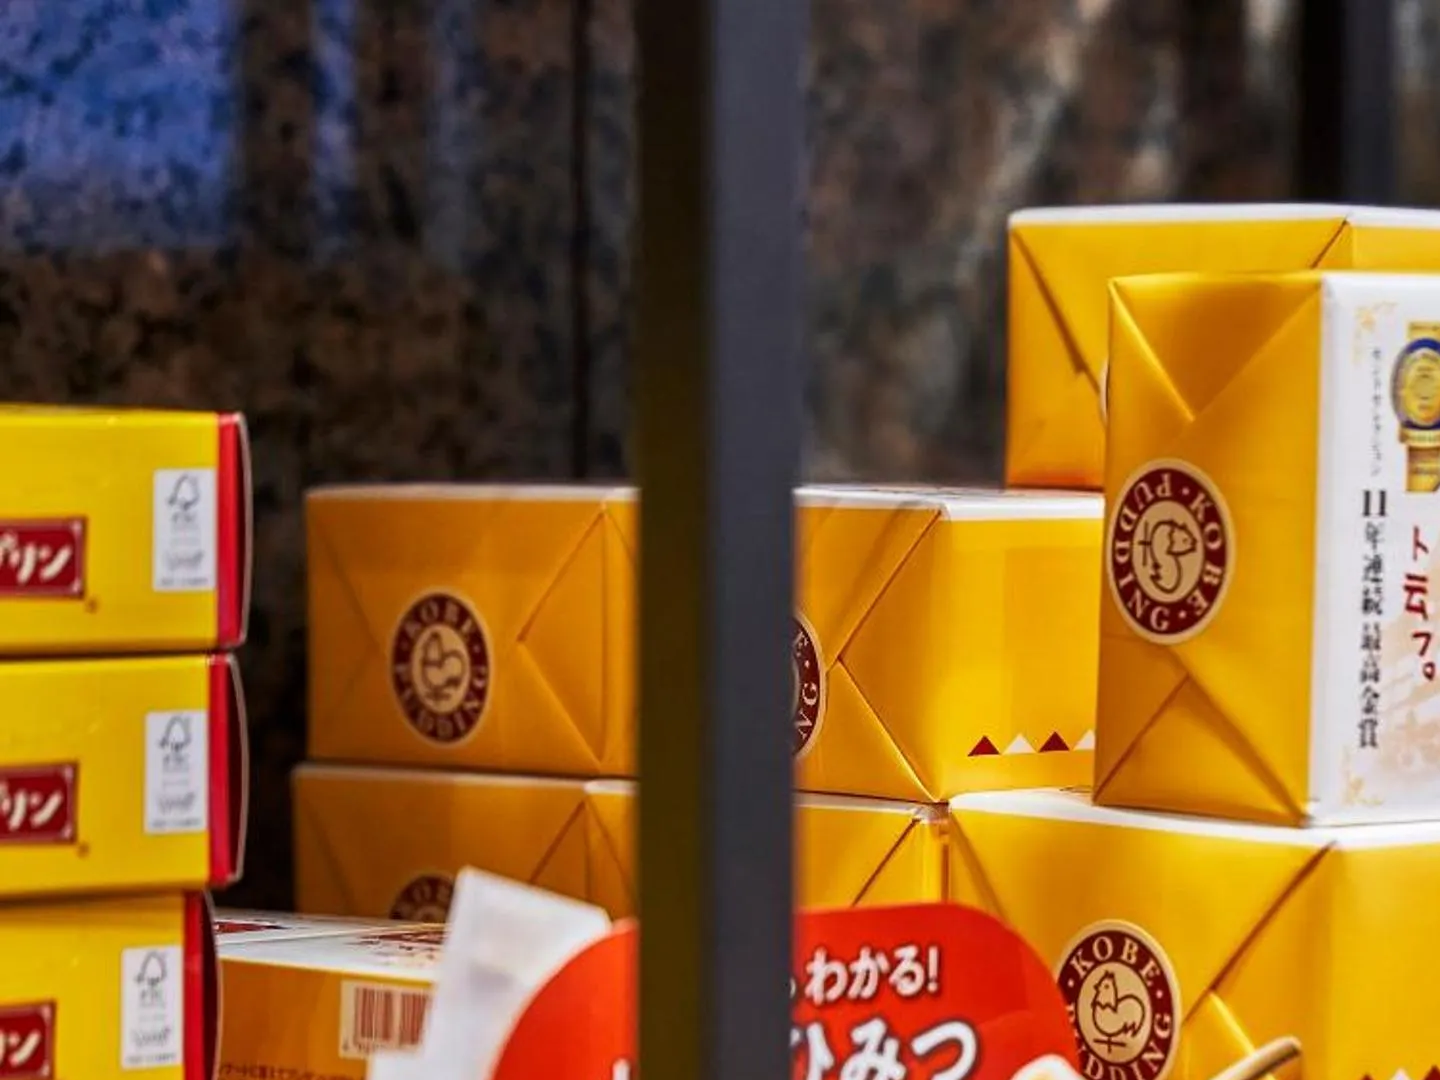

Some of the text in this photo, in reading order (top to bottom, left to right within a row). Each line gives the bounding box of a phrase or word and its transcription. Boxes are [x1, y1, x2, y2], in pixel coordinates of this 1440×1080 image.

[1114, 472, 1224, 632] KOBE PUDDING
[0, 780, 64, 832] リン
[789, 945, 940, 1006] わかる!
[1069, 935, 1161, 987] KOBE
